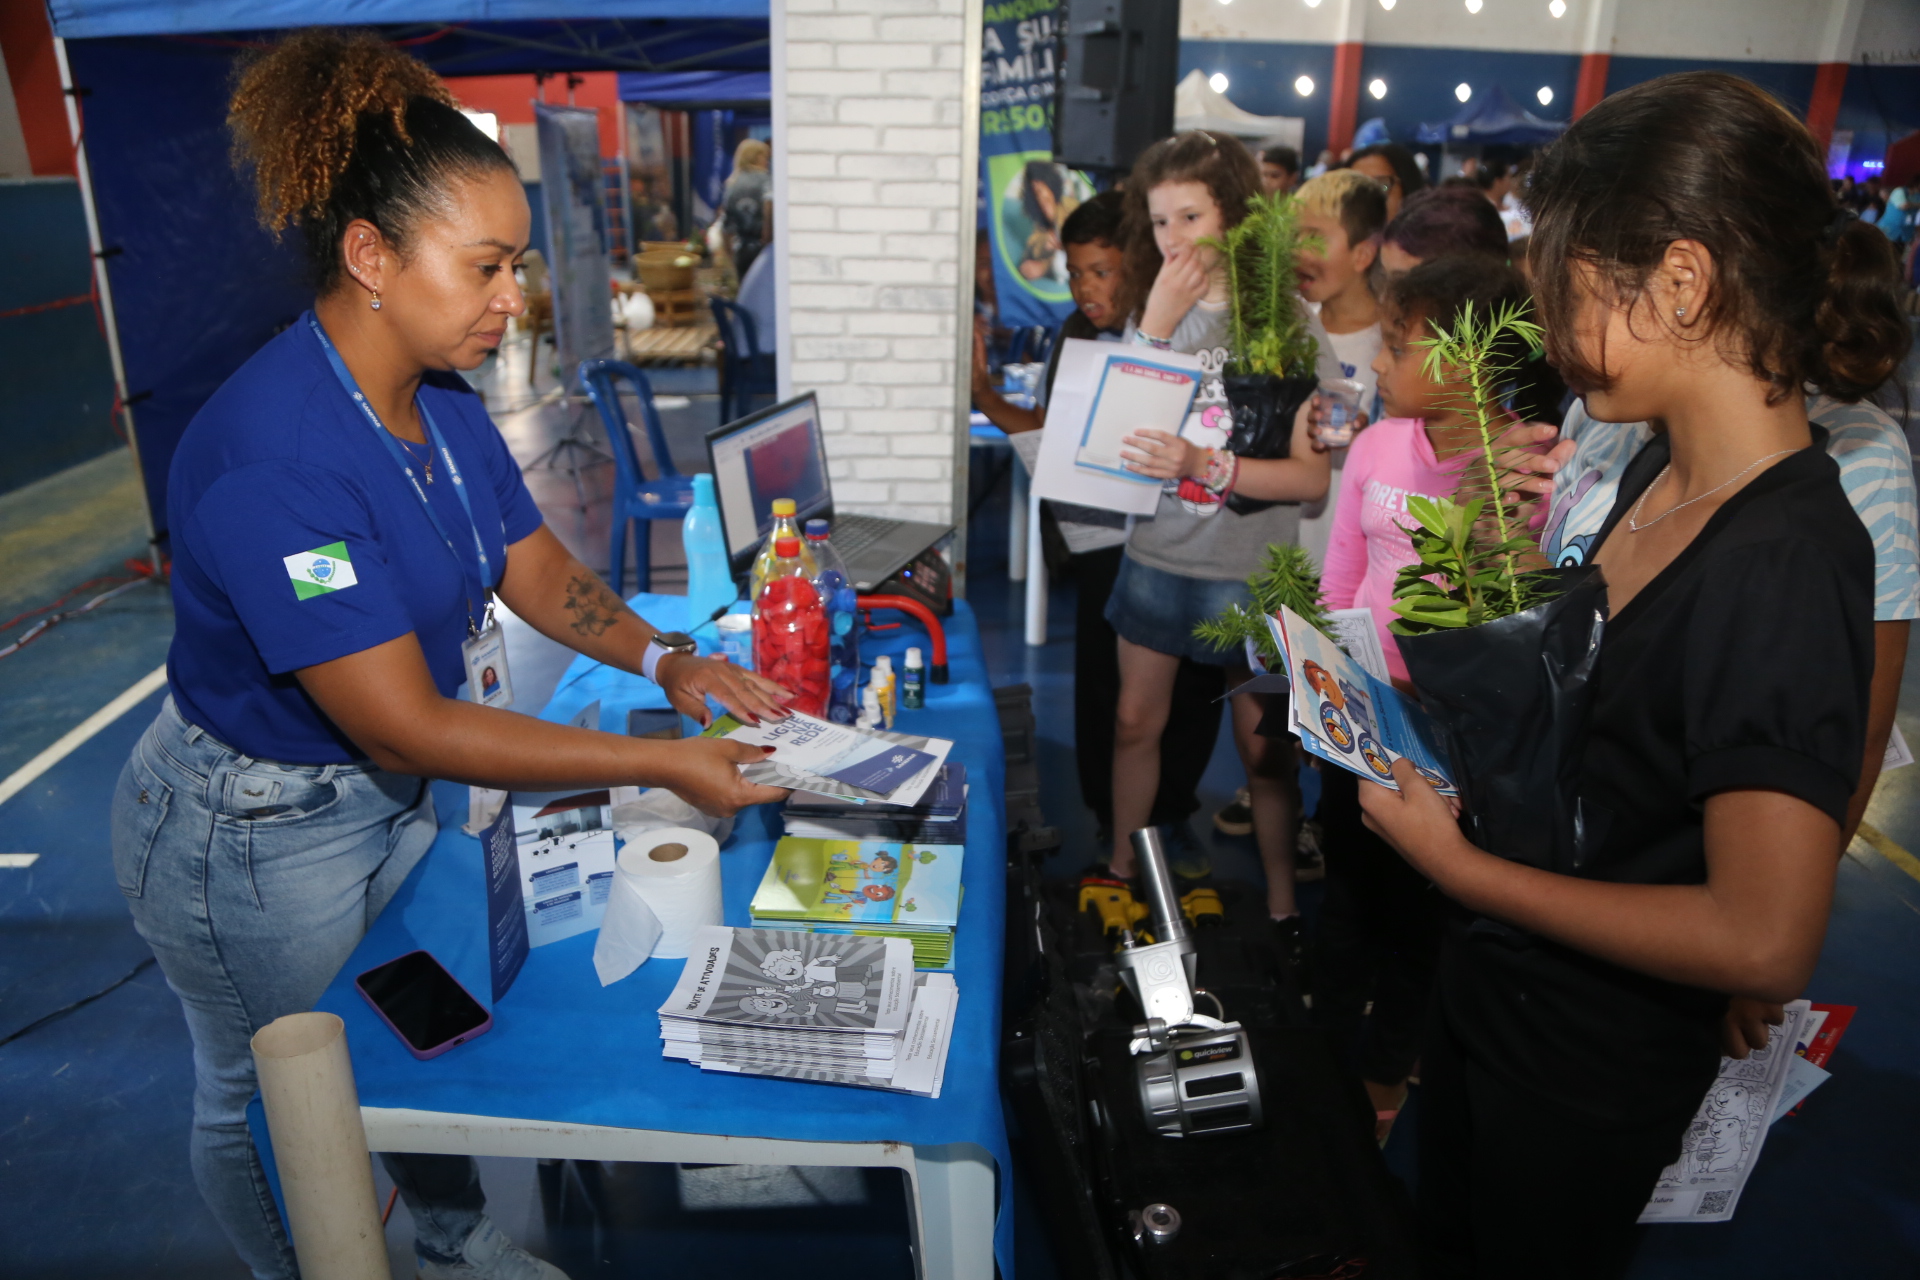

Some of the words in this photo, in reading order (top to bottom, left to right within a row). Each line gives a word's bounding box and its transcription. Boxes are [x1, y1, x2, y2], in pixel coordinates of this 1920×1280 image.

[361, 401, 381, 428] SANEPAR
[441, 447, 458, 476] SANEPAR
[411, 477, 428, 503] SANEPAR
[762, 715, 804, 741] LIGUE
[789, 724, 828, 746] REDE
[791, 720, 817, 735] NA
[700, 947, 720, 985] ATIVIDADES
[1194, 1046, 1234, 1059] quickview
